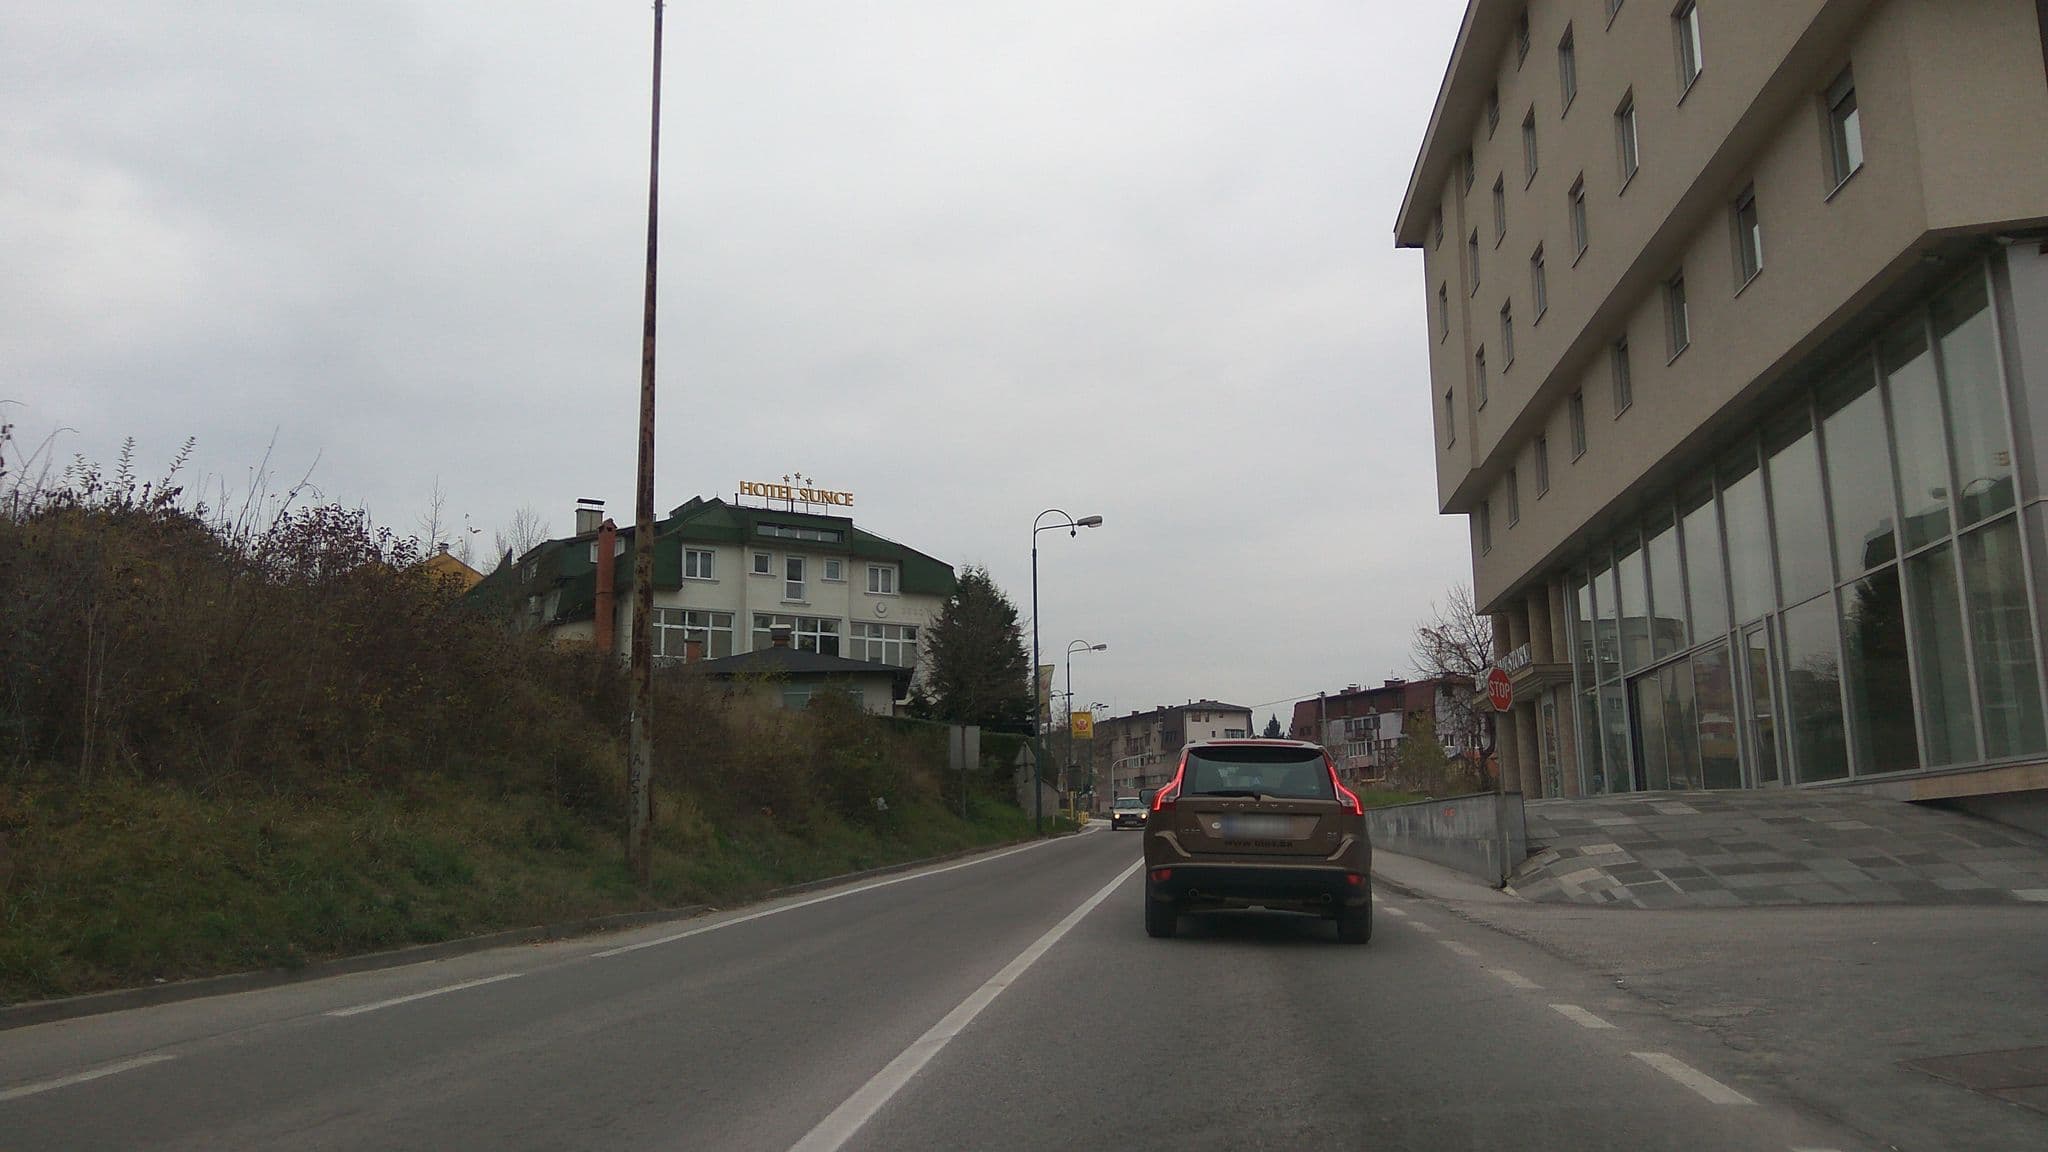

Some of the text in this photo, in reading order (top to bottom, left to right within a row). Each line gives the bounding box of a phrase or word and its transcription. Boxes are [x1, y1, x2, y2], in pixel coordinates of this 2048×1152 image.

[740, 481, 854, 506] HOTEL SUNCE
[1488, 679, 1510, 699] STOP
